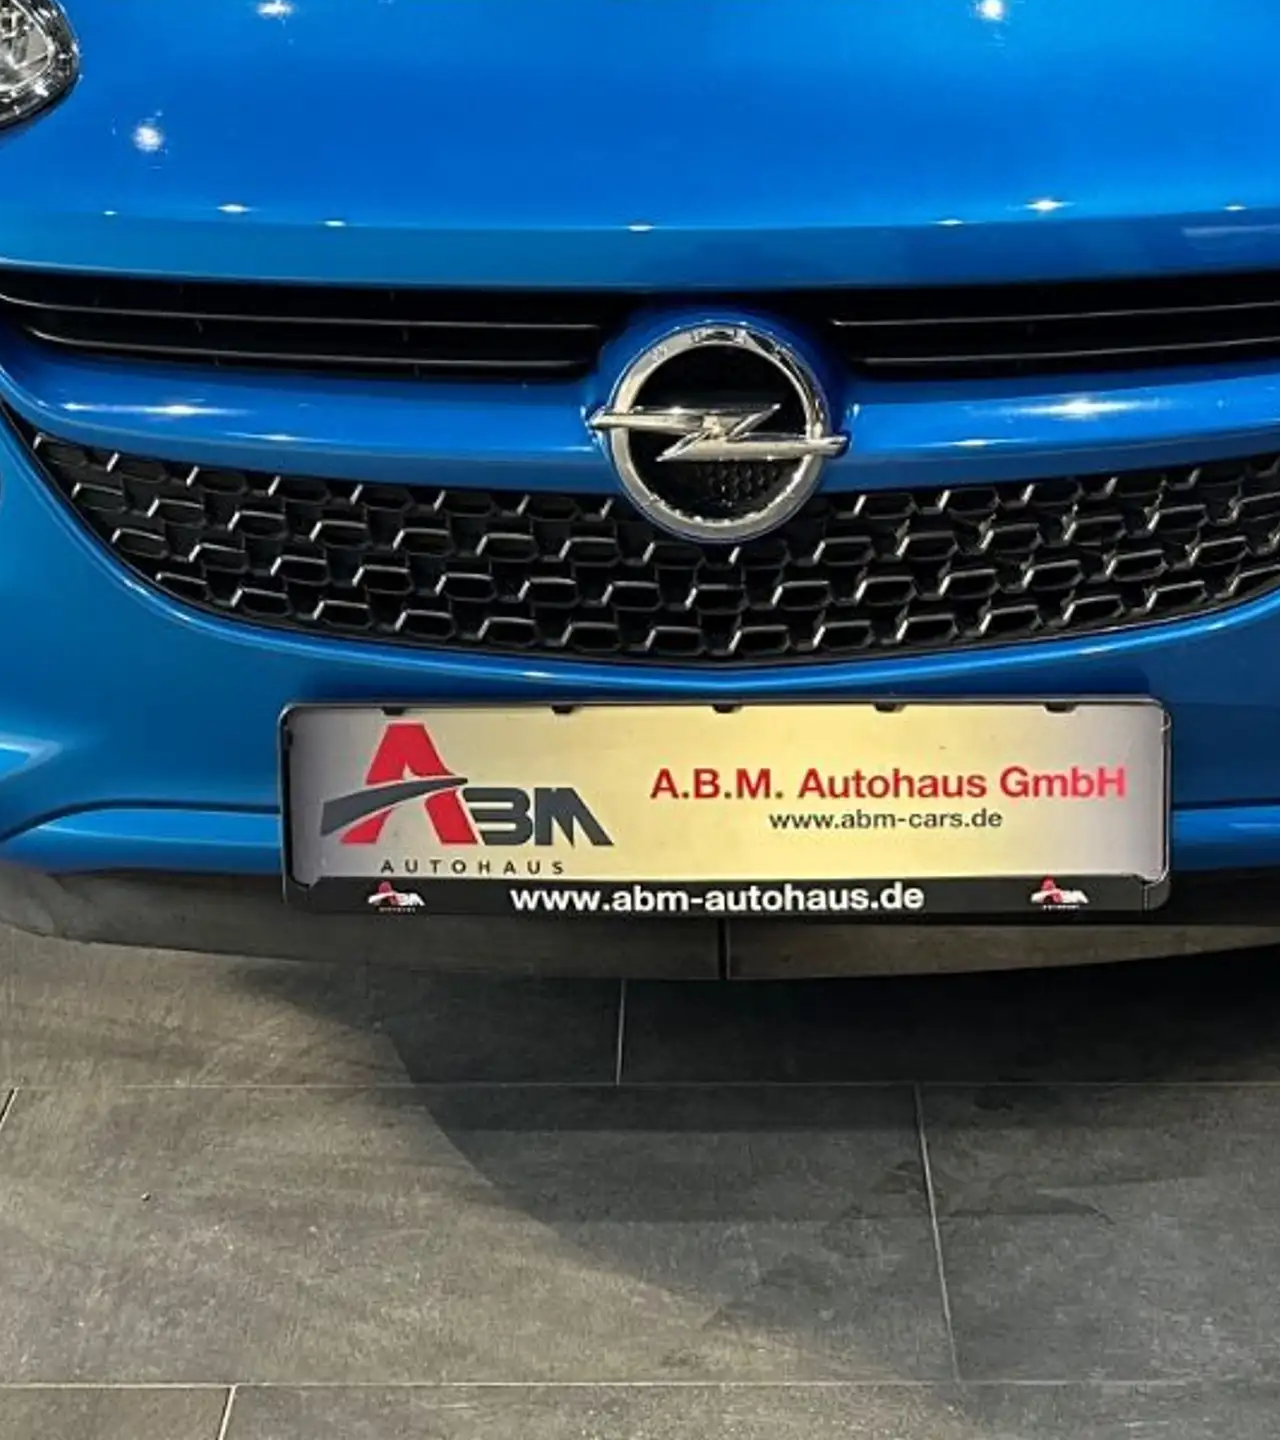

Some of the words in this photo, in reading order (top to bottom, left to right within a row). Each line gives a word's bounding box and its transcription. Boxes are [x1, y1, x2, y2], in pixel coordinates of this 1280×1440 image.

[320, 722, 614, 847] ABM
[650, 767, 784, 799] A.B.M.
[797, 767, 988, 799] Autohaus
[1000, 765, 1126, 798] GmbH
[768, 808, 1003, 830] www.abm-cars.de
[380, 860, 565, 876] AUTOHAUS
[510, 880, 925, 912] www.abm-autohaus.de
